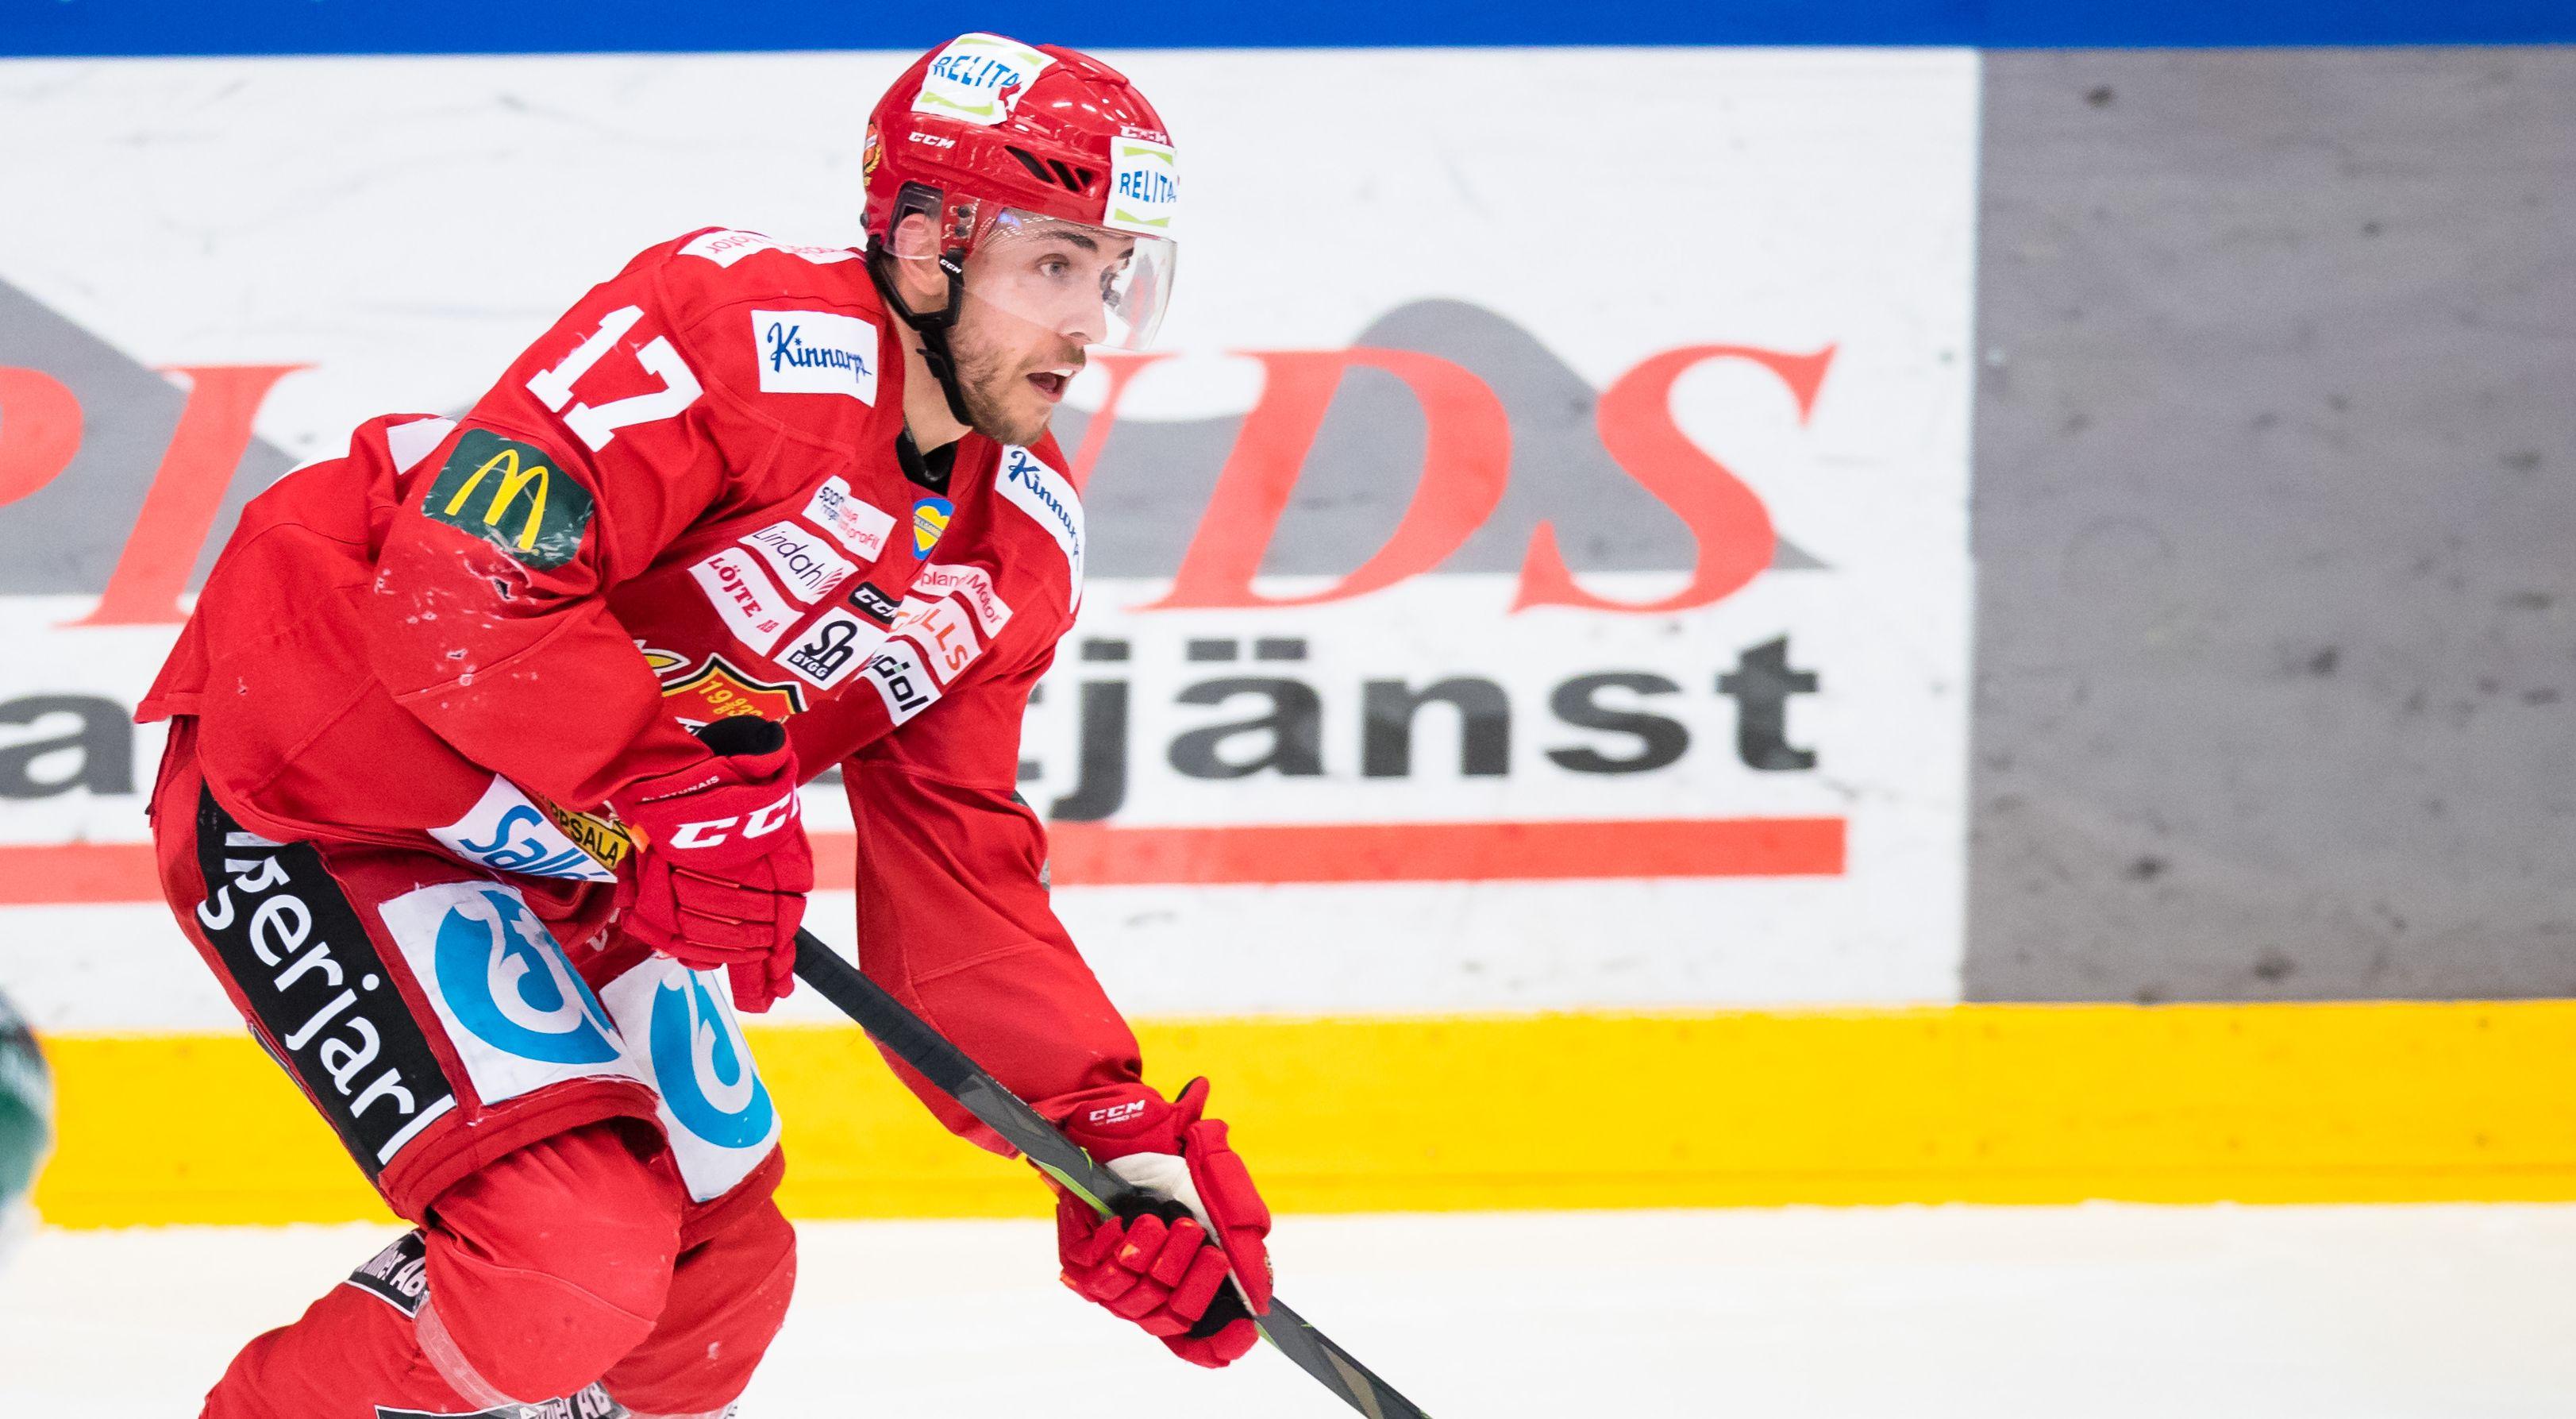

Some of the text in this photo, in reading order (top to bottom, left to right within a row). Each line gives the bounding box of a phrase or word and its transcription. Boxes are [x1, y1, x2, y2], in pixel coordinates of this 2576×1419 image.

[908, 131, 956, 149] CCM
[1119, 170, 1176, 203] RELITA
[939, 258, 962, 274] CCM
[526, 305, 704, 452] 17
[708, 557, 762, 618] LÖJTE
[792, 652, 829, 678] BYGG
[669, 792, 799, 850] CC
[1089, 1099, 1146, 1121] CCM
